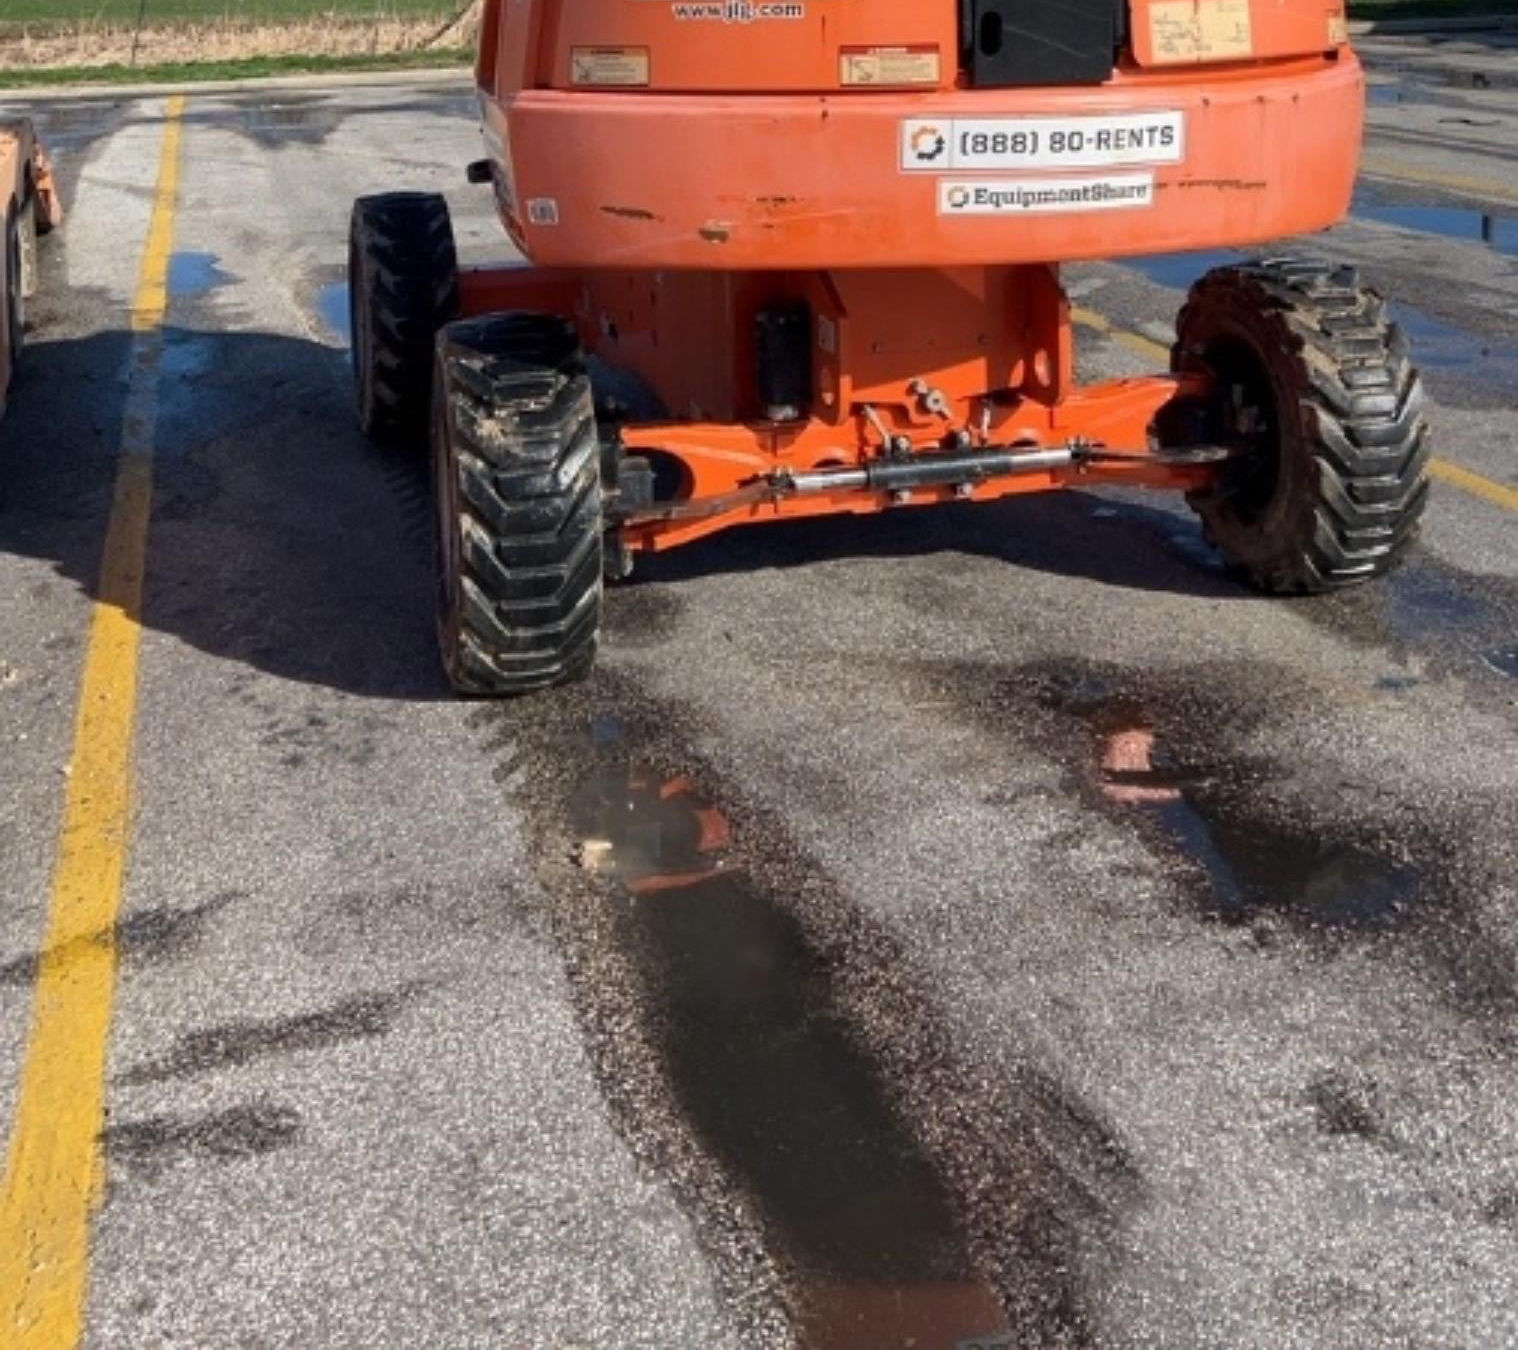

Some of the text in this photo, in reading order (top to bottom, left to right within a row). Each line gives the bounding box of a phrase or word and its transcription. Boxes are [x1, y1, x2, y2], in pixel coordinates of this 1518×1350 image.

[673, 2, 804, 21] www.jlg.com
[960, 125, 1174, 155] (888) 80-RENTS
[973, 183, 1148, 207] EquipmentShare
